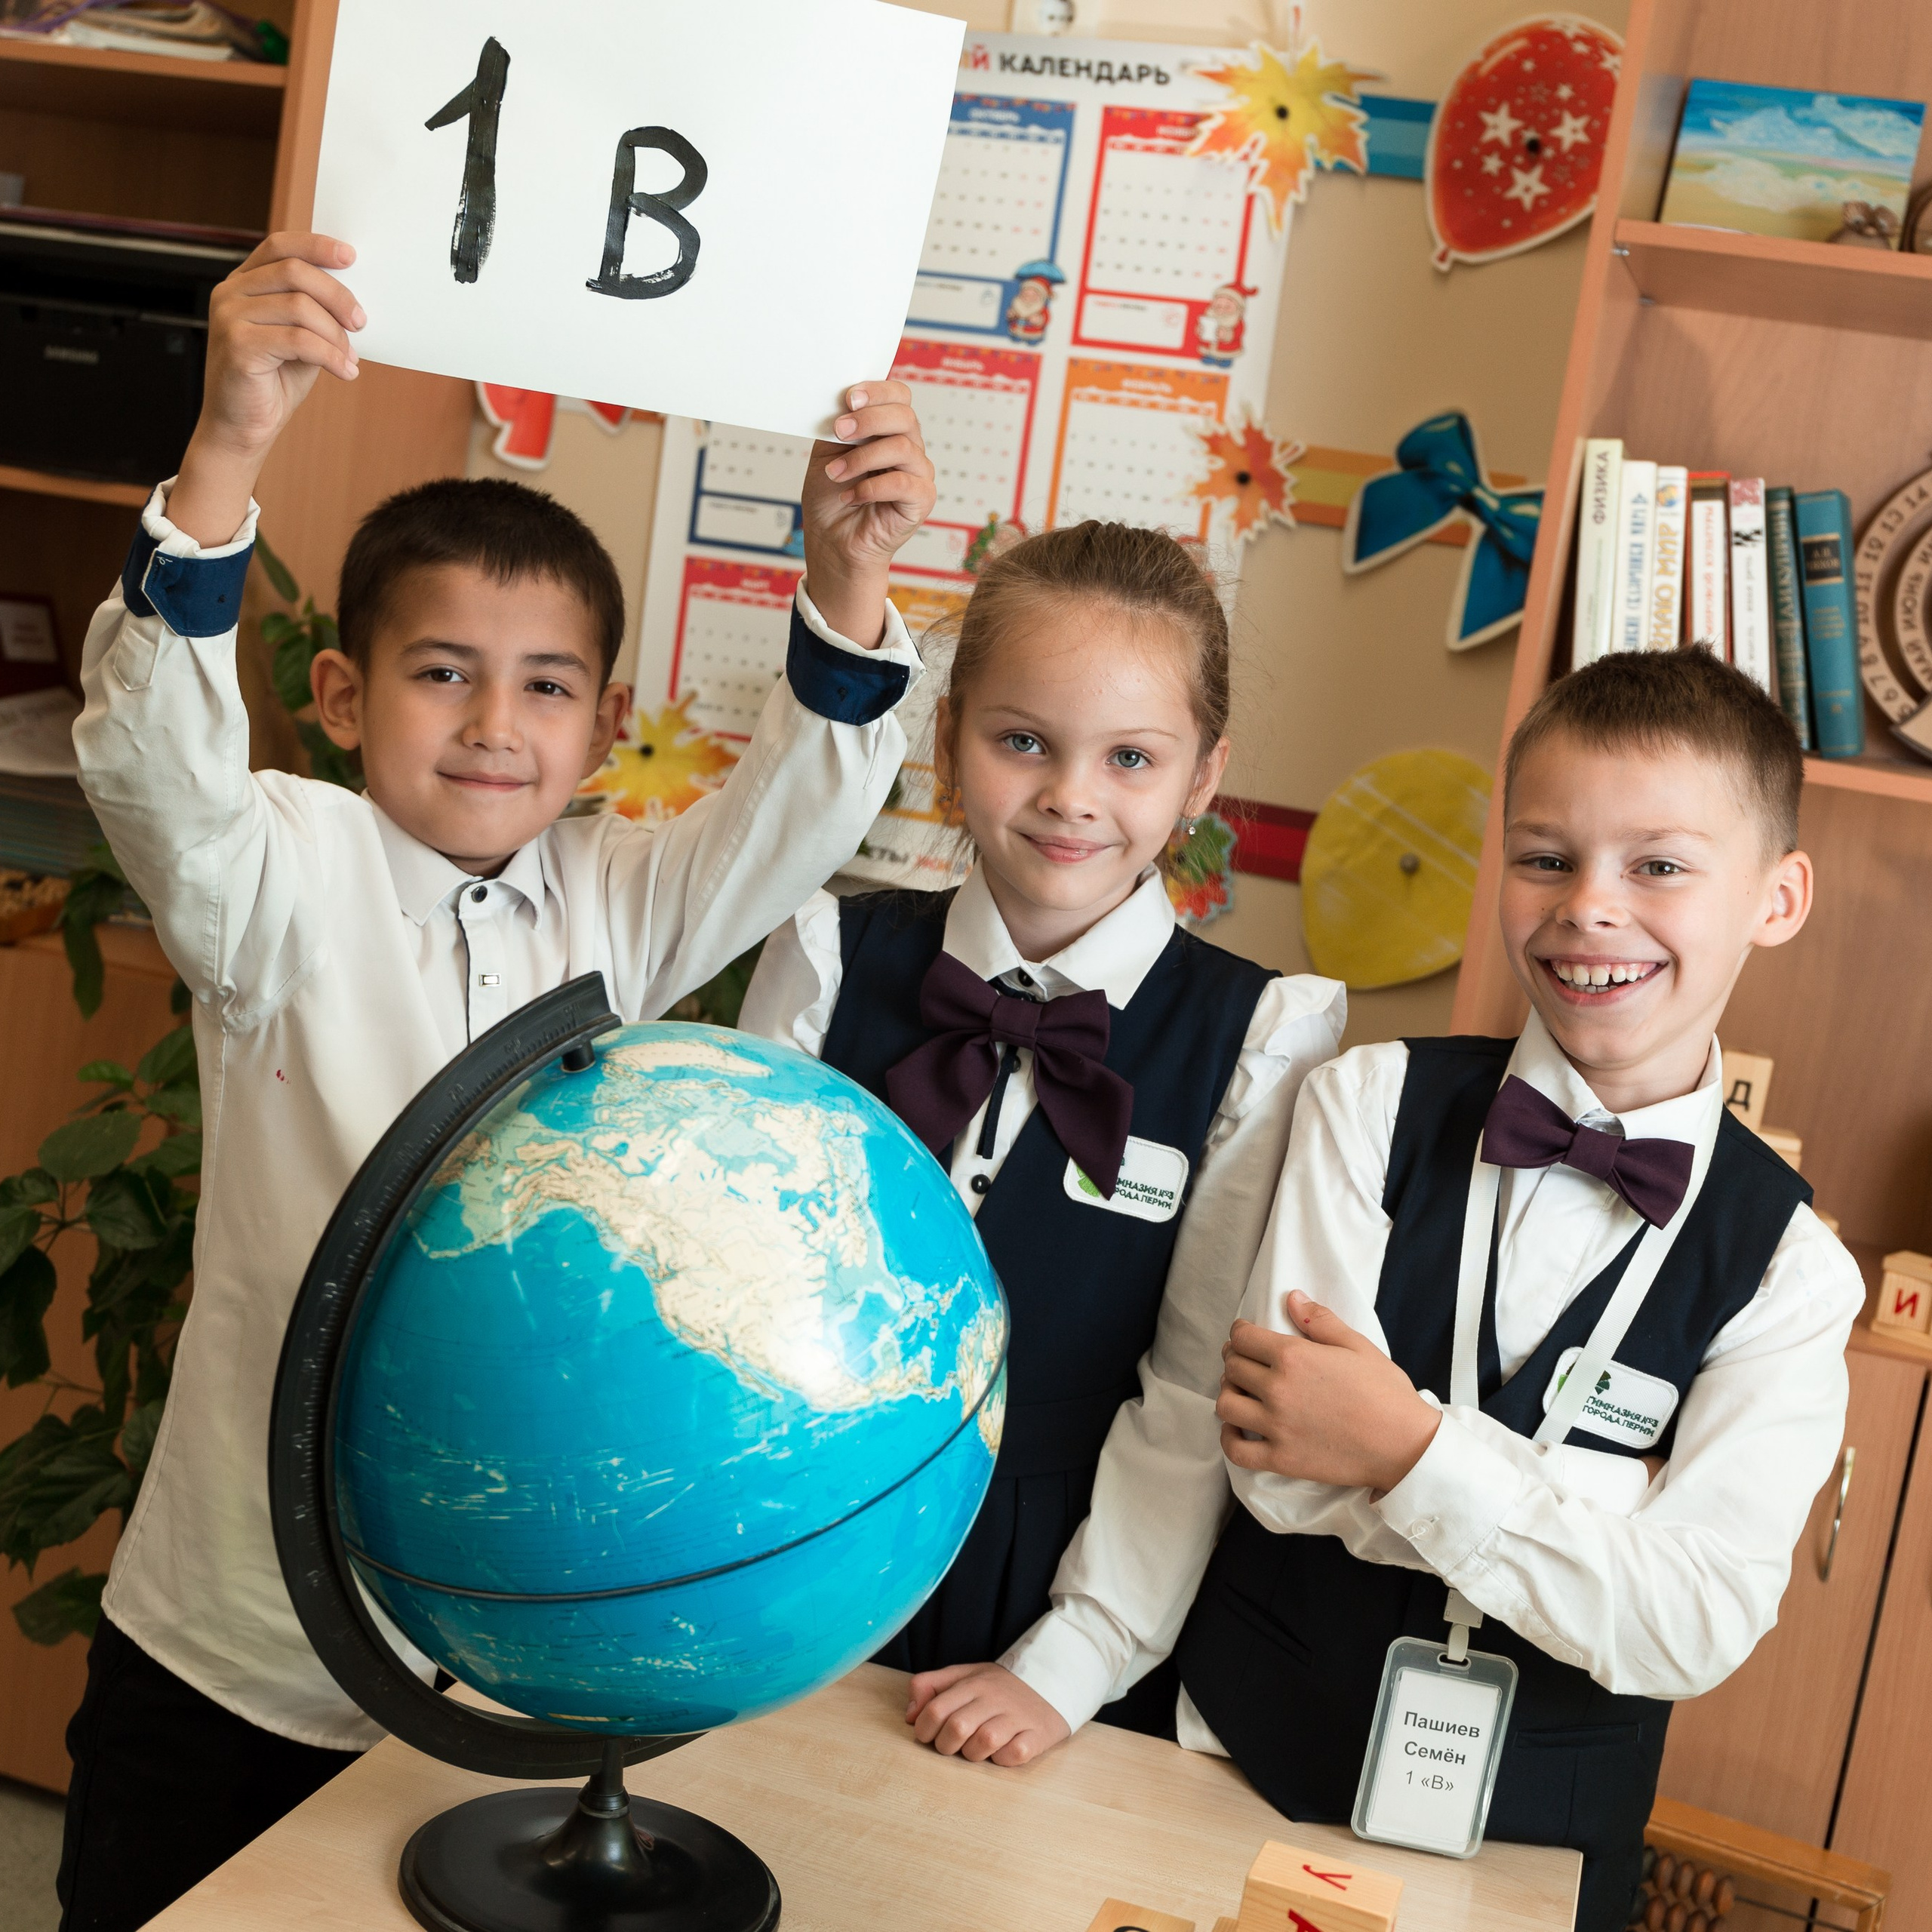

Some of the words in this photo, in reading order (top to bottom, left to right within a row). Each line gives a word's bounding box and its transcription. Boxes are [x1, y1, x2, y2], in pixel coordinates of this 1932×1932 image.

[999, 52, 1171, 86] КАЛЕНДАРЬ
[424, 35, 511, 284] 1
[586, 126, 708, 300] В
[1592, 451, 1609, 525] ФИЗИКА
[1657, 521, 1678, 577] МИР
[1901, 572, 1924, 630] ИЮНЬ
[1869, 675, 1885, 688] 7
[1726, 1079, 1752, 1112] Д
[1116, 1177, 1158, 1195] МНАЗИЯ
[1140, 1195, 1173, 1210] ПЕРМИ
[1894, 1287, 1919, 1318] И
[1583, 1404, 1620, 1423] ГОРОДА
[1622, 1420, 1655, 1437] ПЕРМИ
[1586, 1395, 1641, 1422] ГИМНАЗИЯ
[1640, 1416, 1659, 1429] №3
[1403, 1711, 1481, 1739] Пашиев
[1404, 1741, 1467, 1766] Семён
[1405, 1770, 1413, 1786] 1
[1421, 1774, 1454, 1792] «В»
